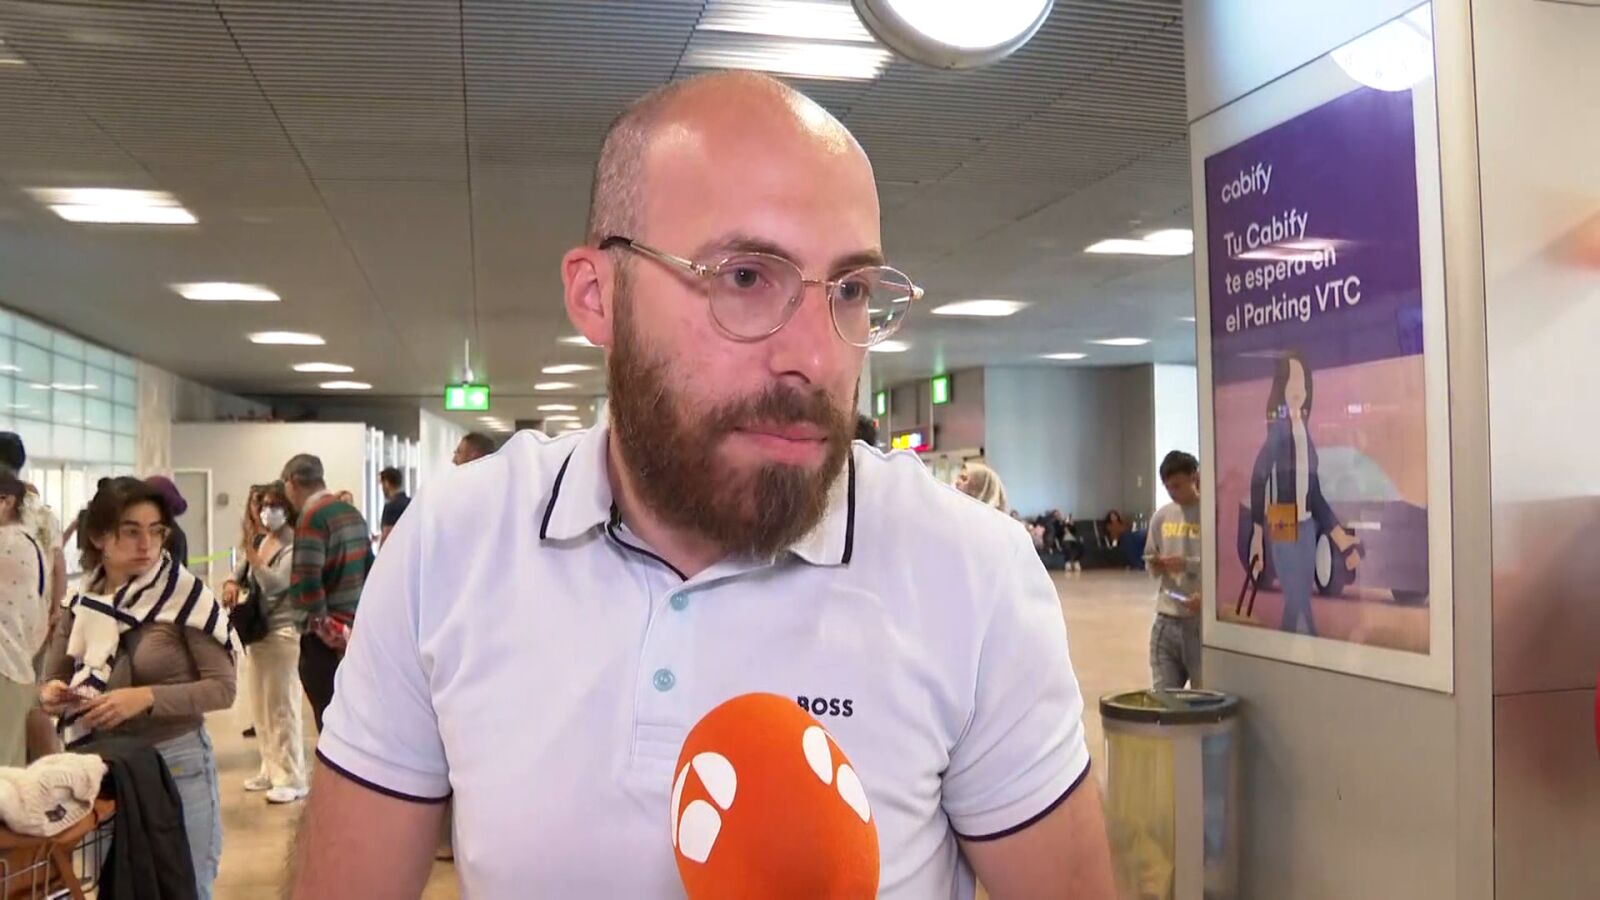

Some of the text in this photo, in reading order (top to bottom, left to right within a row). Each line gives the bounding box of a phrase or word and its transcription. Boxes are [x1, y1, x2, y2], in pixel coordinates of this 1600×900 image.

[1221, 162, 1272, 203] cabify
[1223, 208, 1308, 256] Tu Cabify
[1225, 272, 1241, 295] te
[1225, 276, 1360, 332] el Parking VTC
